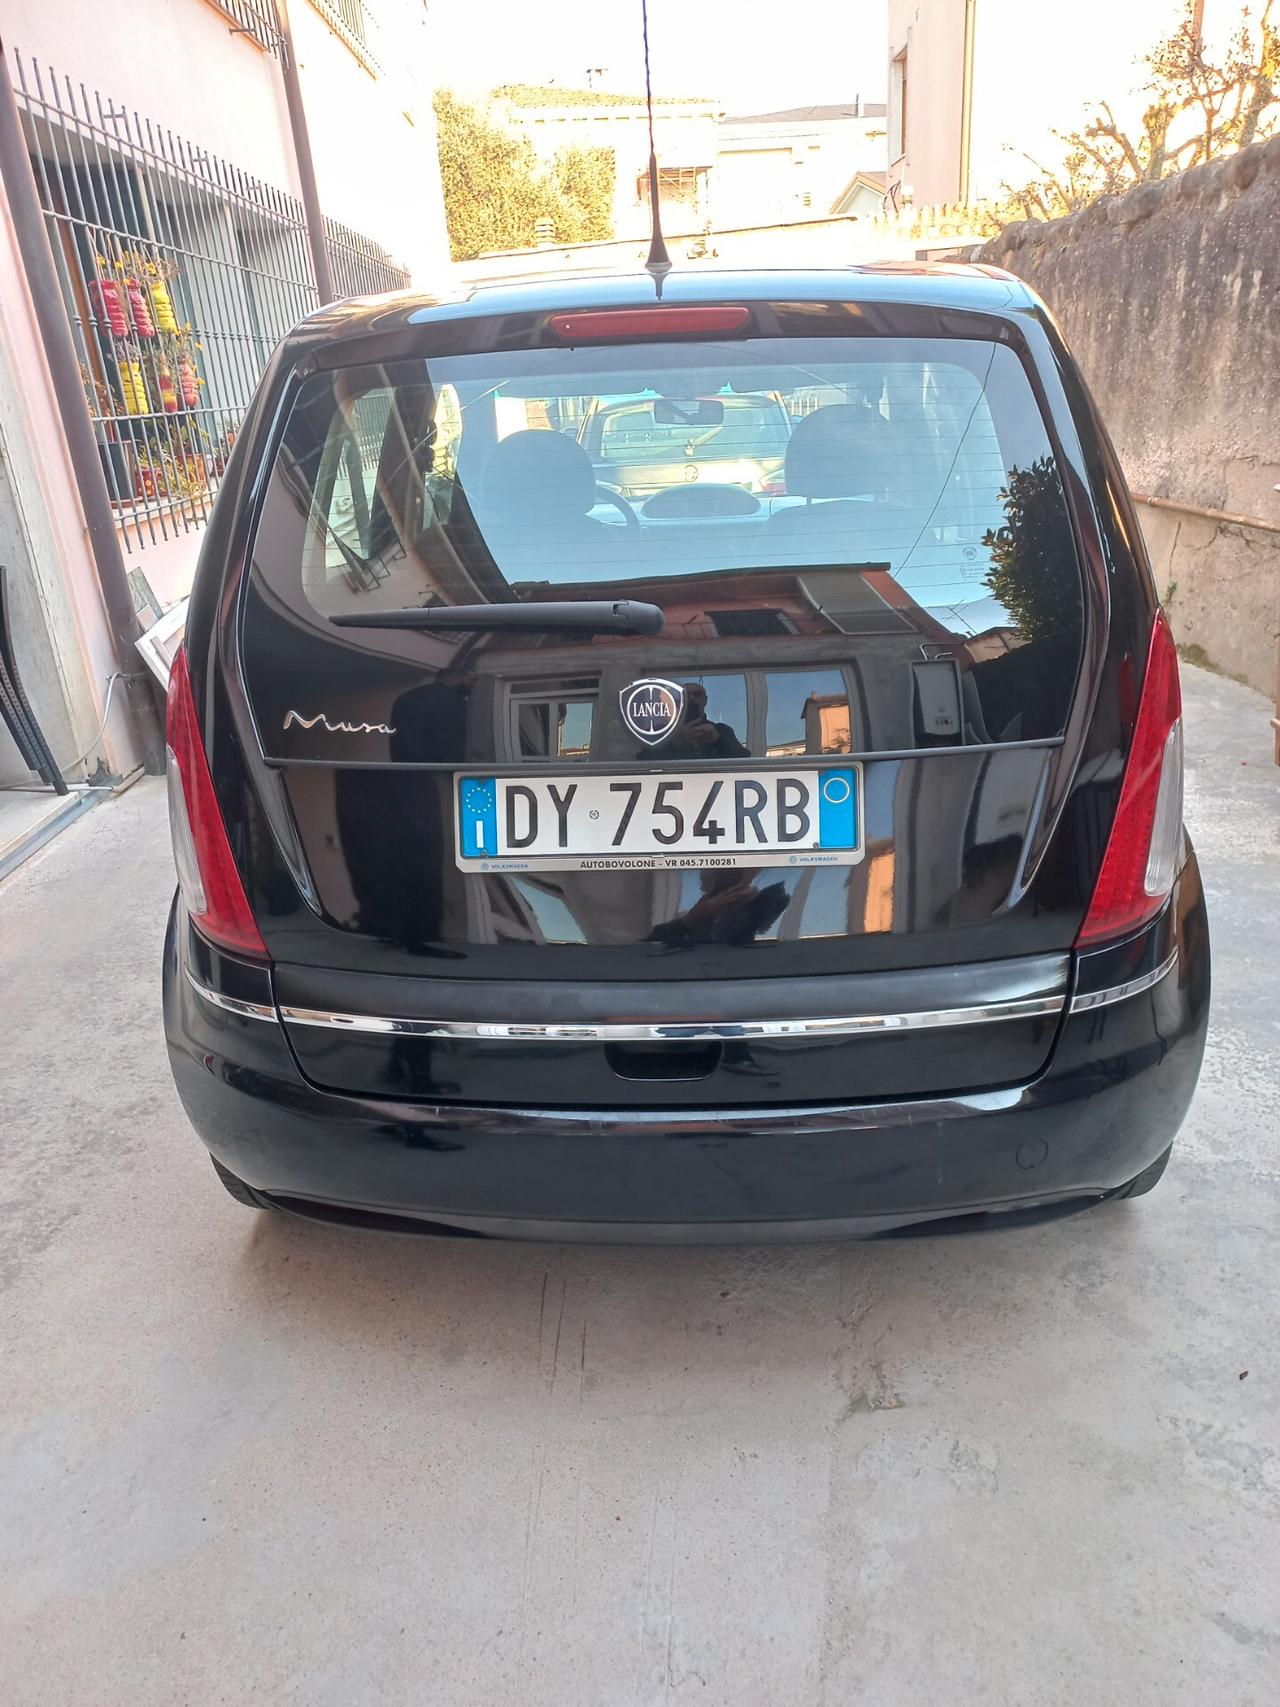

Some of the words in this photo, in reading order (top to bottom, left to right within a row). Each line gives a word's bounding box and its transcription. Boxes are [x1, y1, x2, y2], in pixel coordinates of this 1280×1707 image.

[632, 701, 672, 718] LANCIA
[283, 709, 396, 735] Musa
[506, 783, 577, 848] DY
[610, 778, 811, 846] 754RB
[580, 859, 656, 869] AUTOBOVOLONE
[665, 858, 678, 868] VR
[680, 857, 737, 868] 045.7100281
